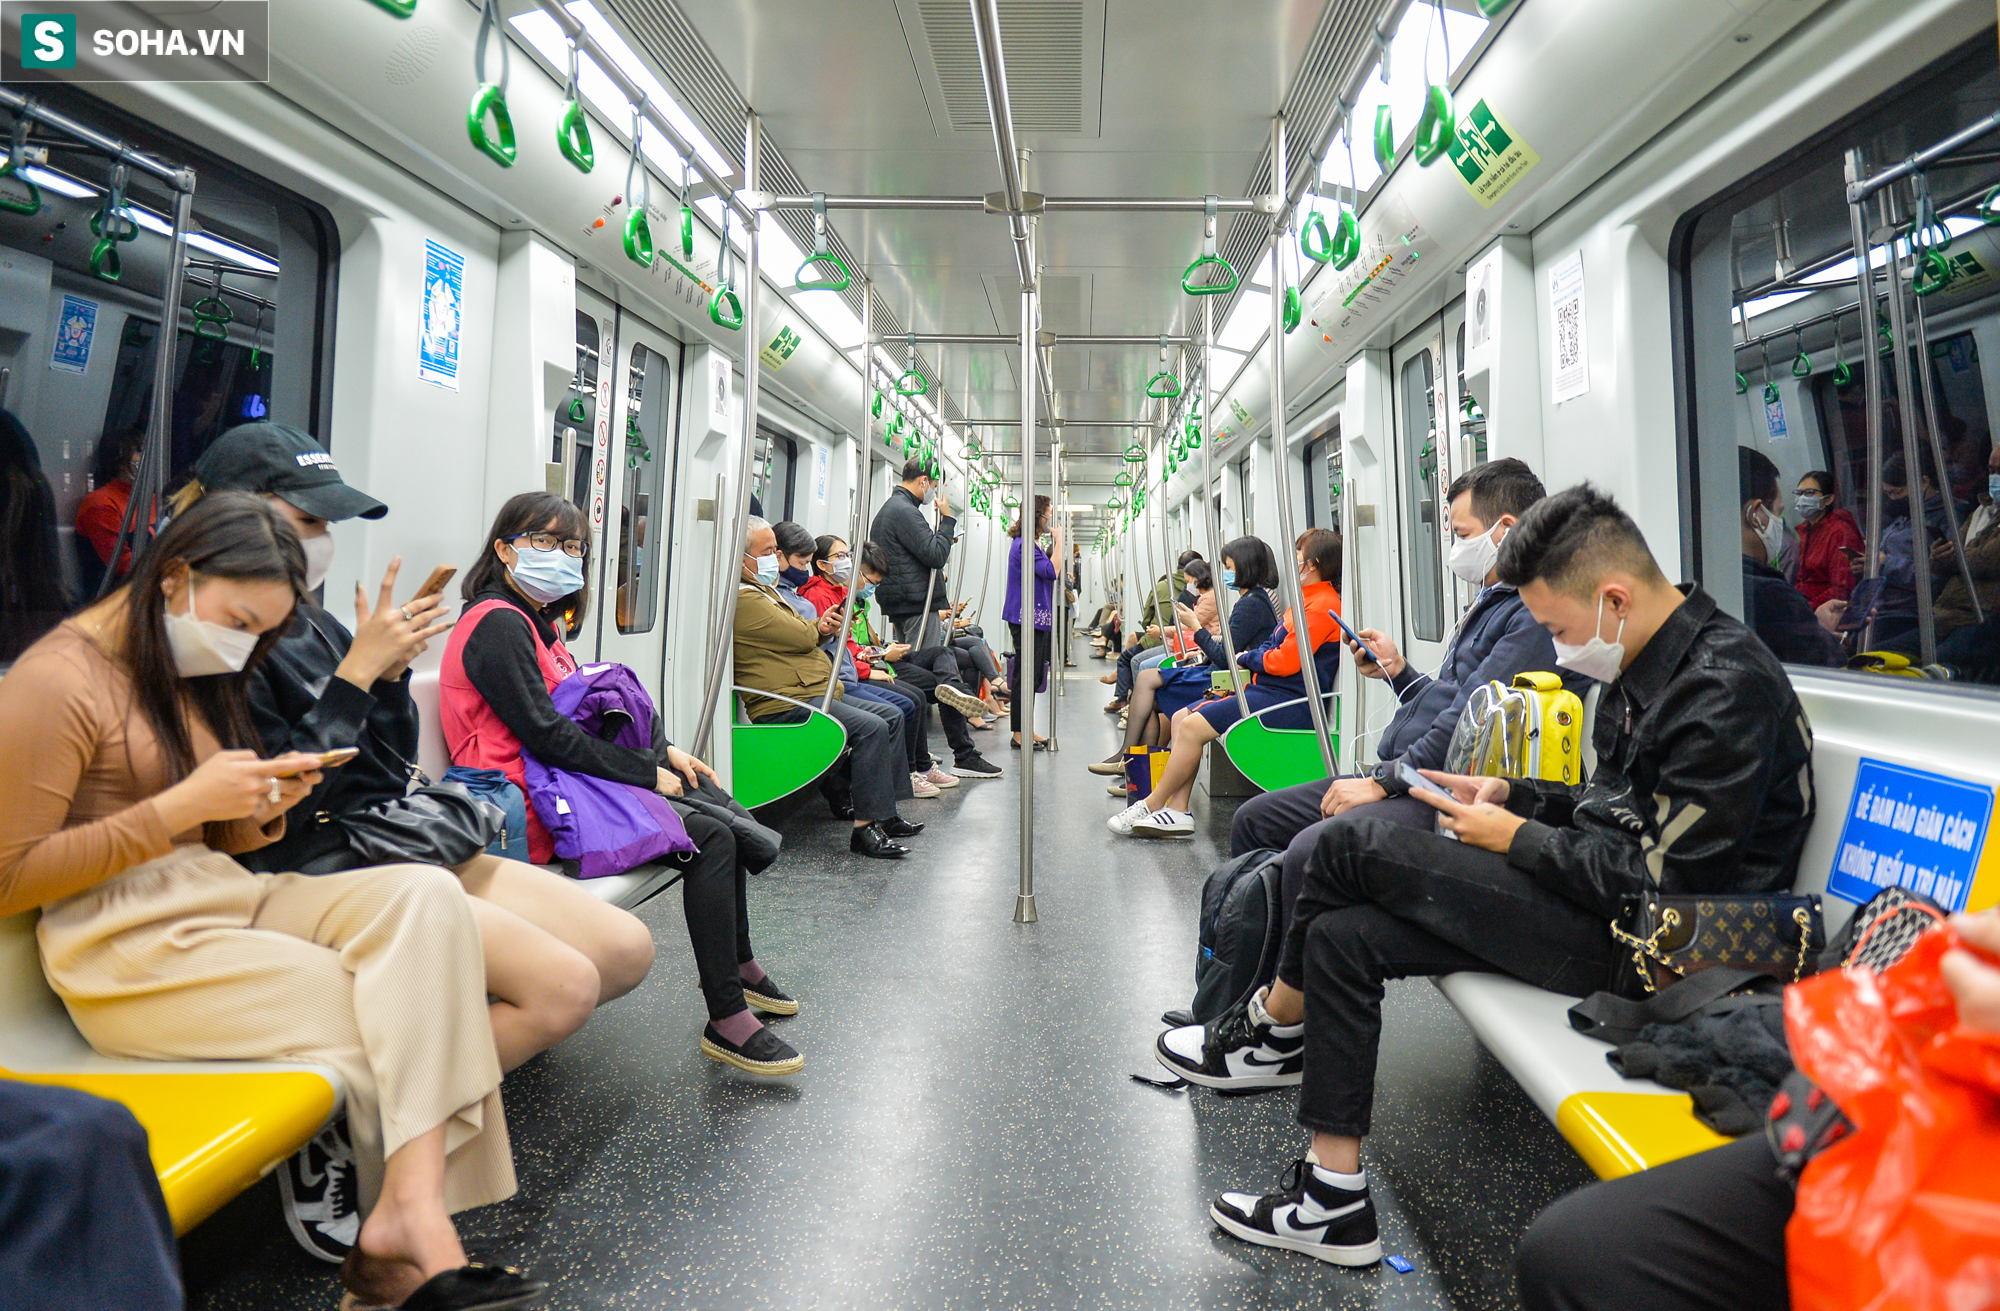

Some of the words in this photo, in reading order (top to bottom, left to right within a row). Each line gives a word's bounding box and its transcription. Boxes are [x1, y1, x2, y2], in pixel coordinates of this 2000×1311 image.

[1892, 792, 1917, 834] BẢO
[1941, 811, 1977, 852] CÁCH
[1838, 841, 1877, 882] KHÔNG
